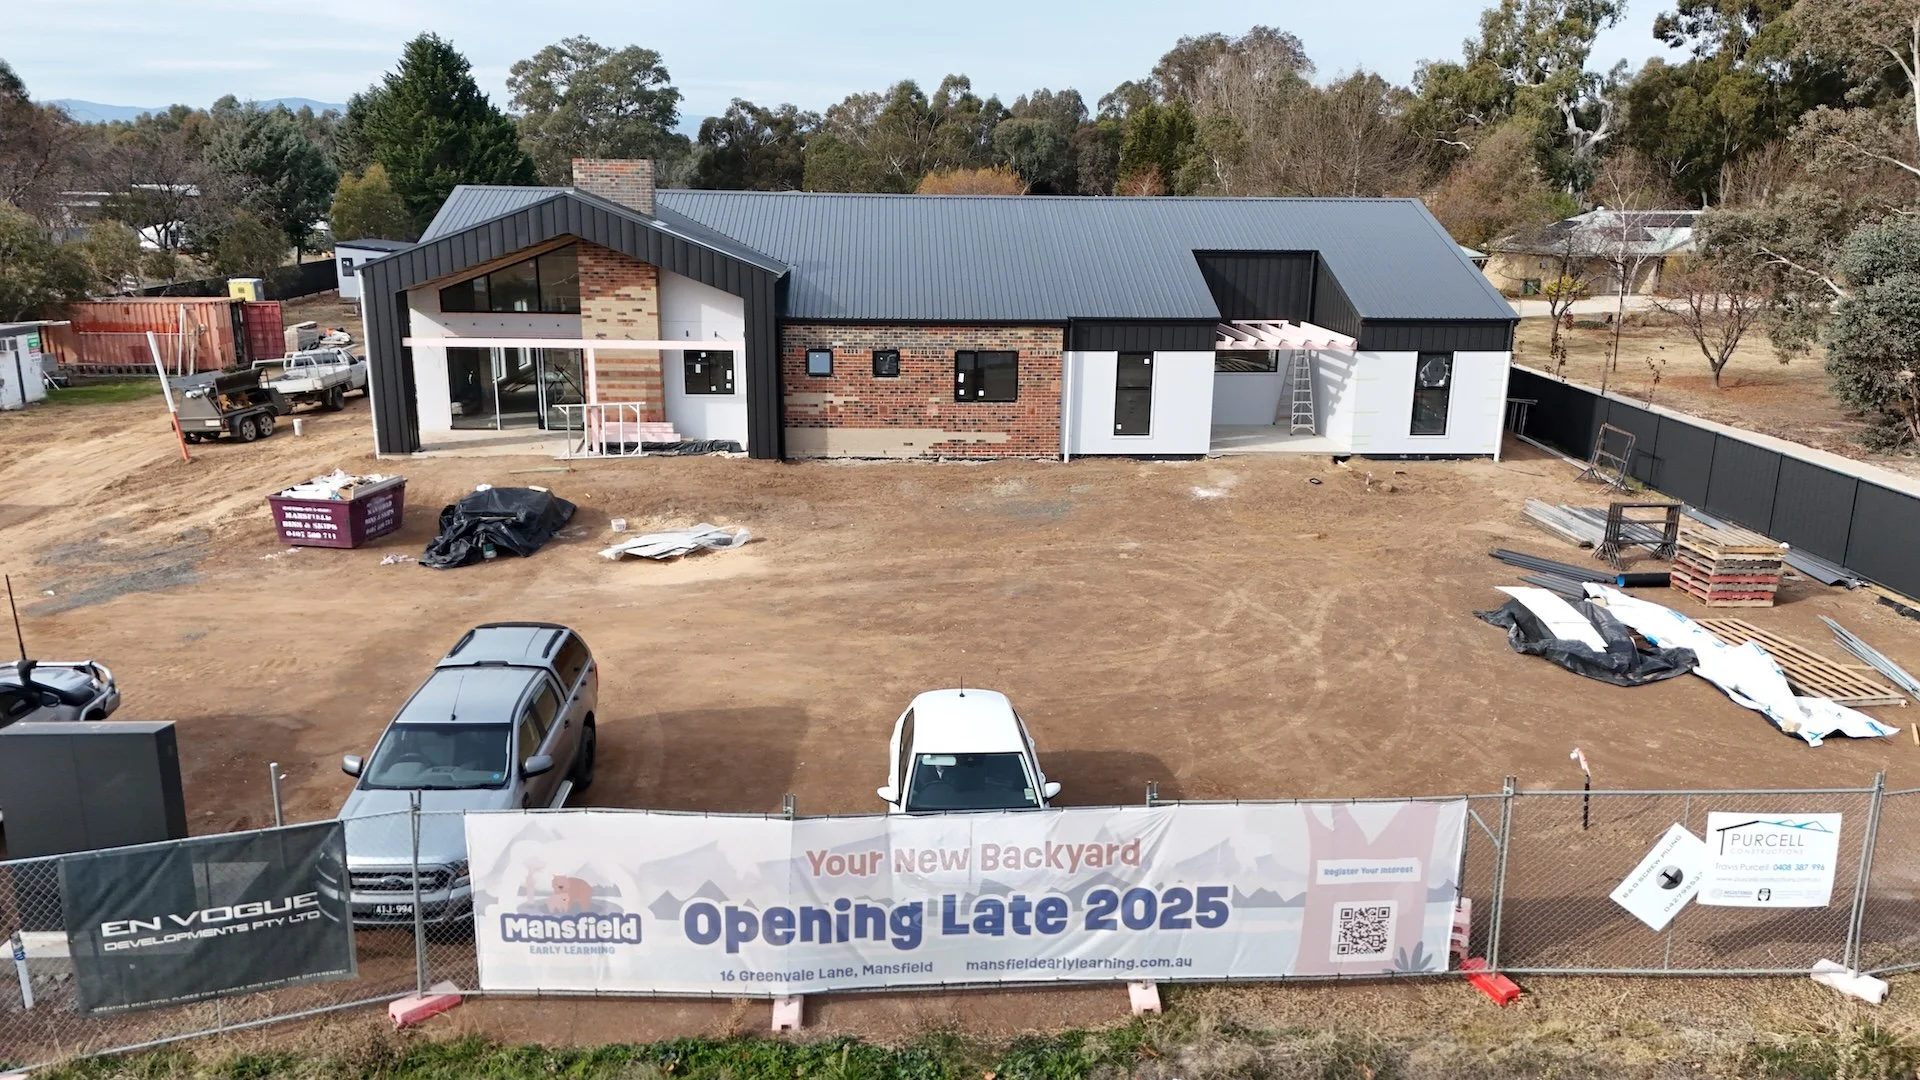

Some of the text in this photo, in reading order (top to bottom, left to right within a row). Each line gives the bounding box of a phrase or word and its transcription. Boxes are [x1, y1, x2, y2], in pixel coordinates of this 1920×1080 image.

[1731, 833, 1804, 847] PURCELL
[805, 838, 1141, 877] Your New Backyard
[1715, 863, 1738, 871] Travis
[1740, 863, 1769, 871] Purcell
[1324, 868, 1359, 877] Register
[1380, 866, 1413, 874] Interest
[101, 891, 319, 937] EN VOGUE
[684, 886, 1230, 954] Opening Late 2025
[104, 910, 321, 951] DEVELOPMENTS PTY LTD
[504, 916, 638, 940] Mansfield
[529, 945, 616, 955] EARLY LEARNING
[720, 961, 933, 983] 16 Greenvale Lane, Mansfield
[966, 957, 1193, 971] mansfieldearlylearning.com.au
